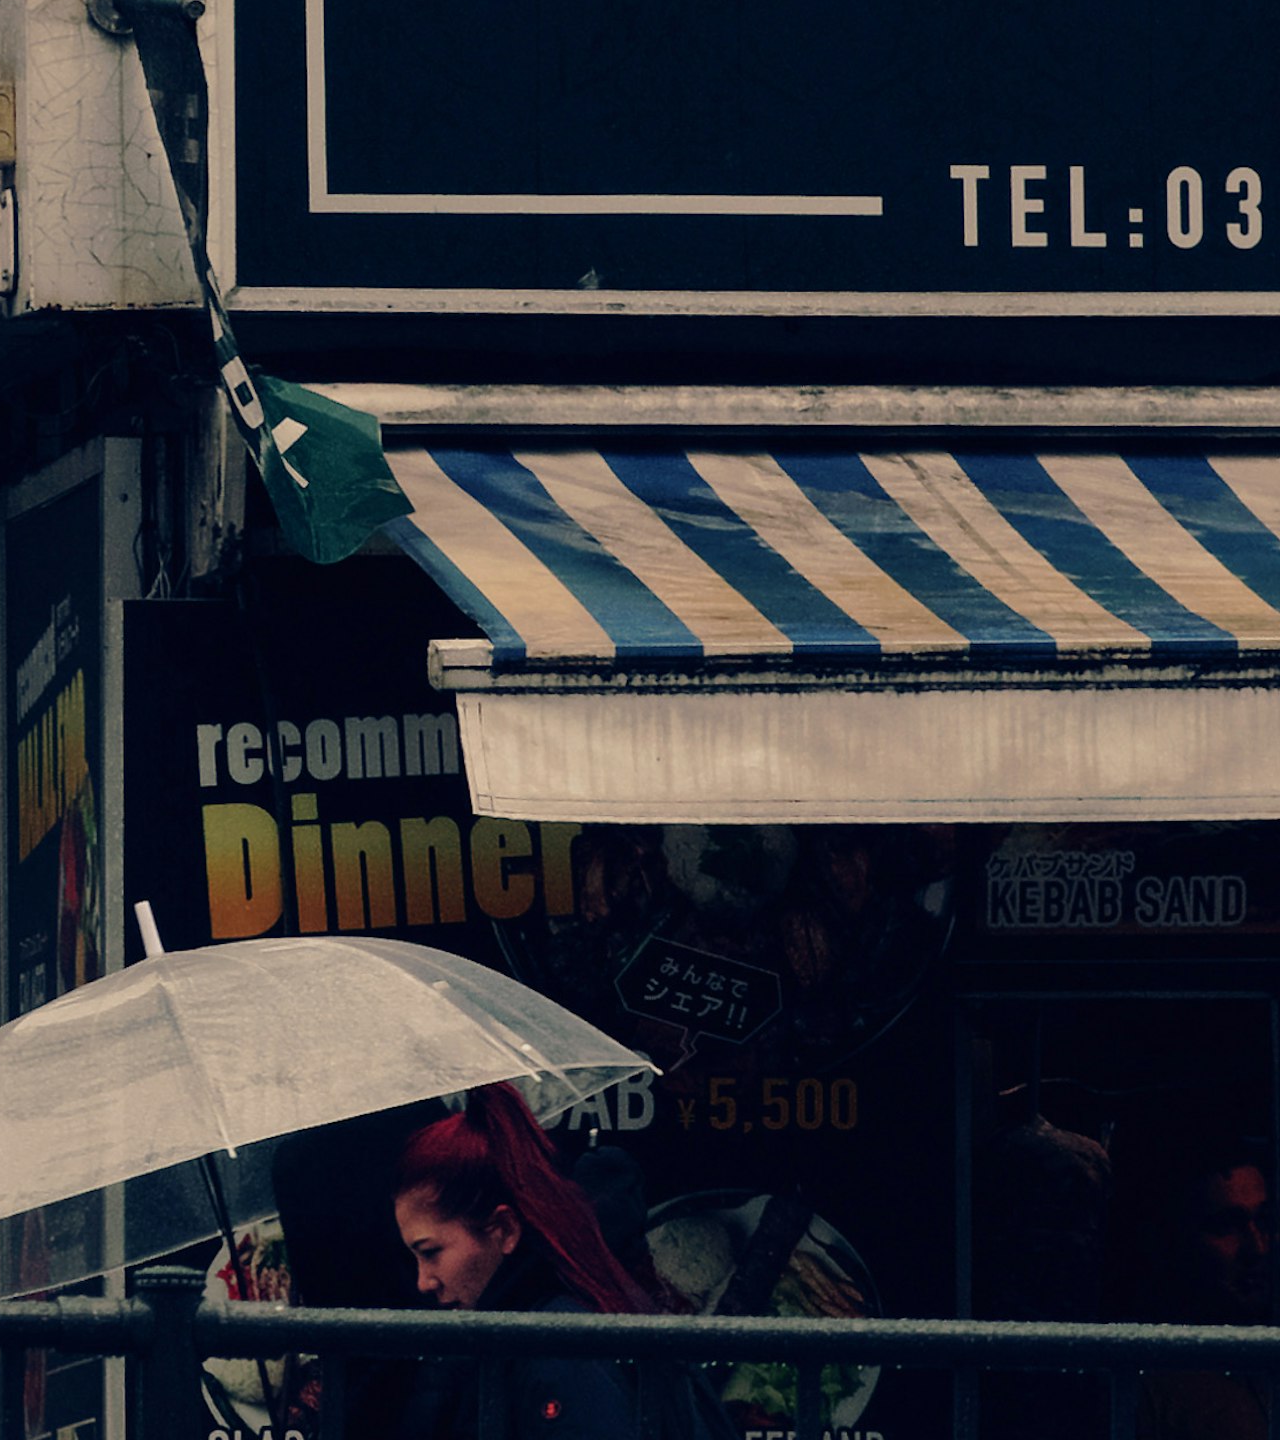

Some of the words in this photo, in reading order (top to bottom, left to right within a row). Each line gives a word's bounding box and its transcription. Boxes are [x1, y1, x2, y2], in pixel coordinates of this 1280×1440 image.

[196, 712, 460, 787] recomm
[202, 792, 584, 940] Dinner
[989, 878, 1122, 926] KEBAB
[1136, 877, 1247, 926] SAND
[659, 956, 748, 998] みんなで
[676, 1076, 859, 1134] ¥5,500
